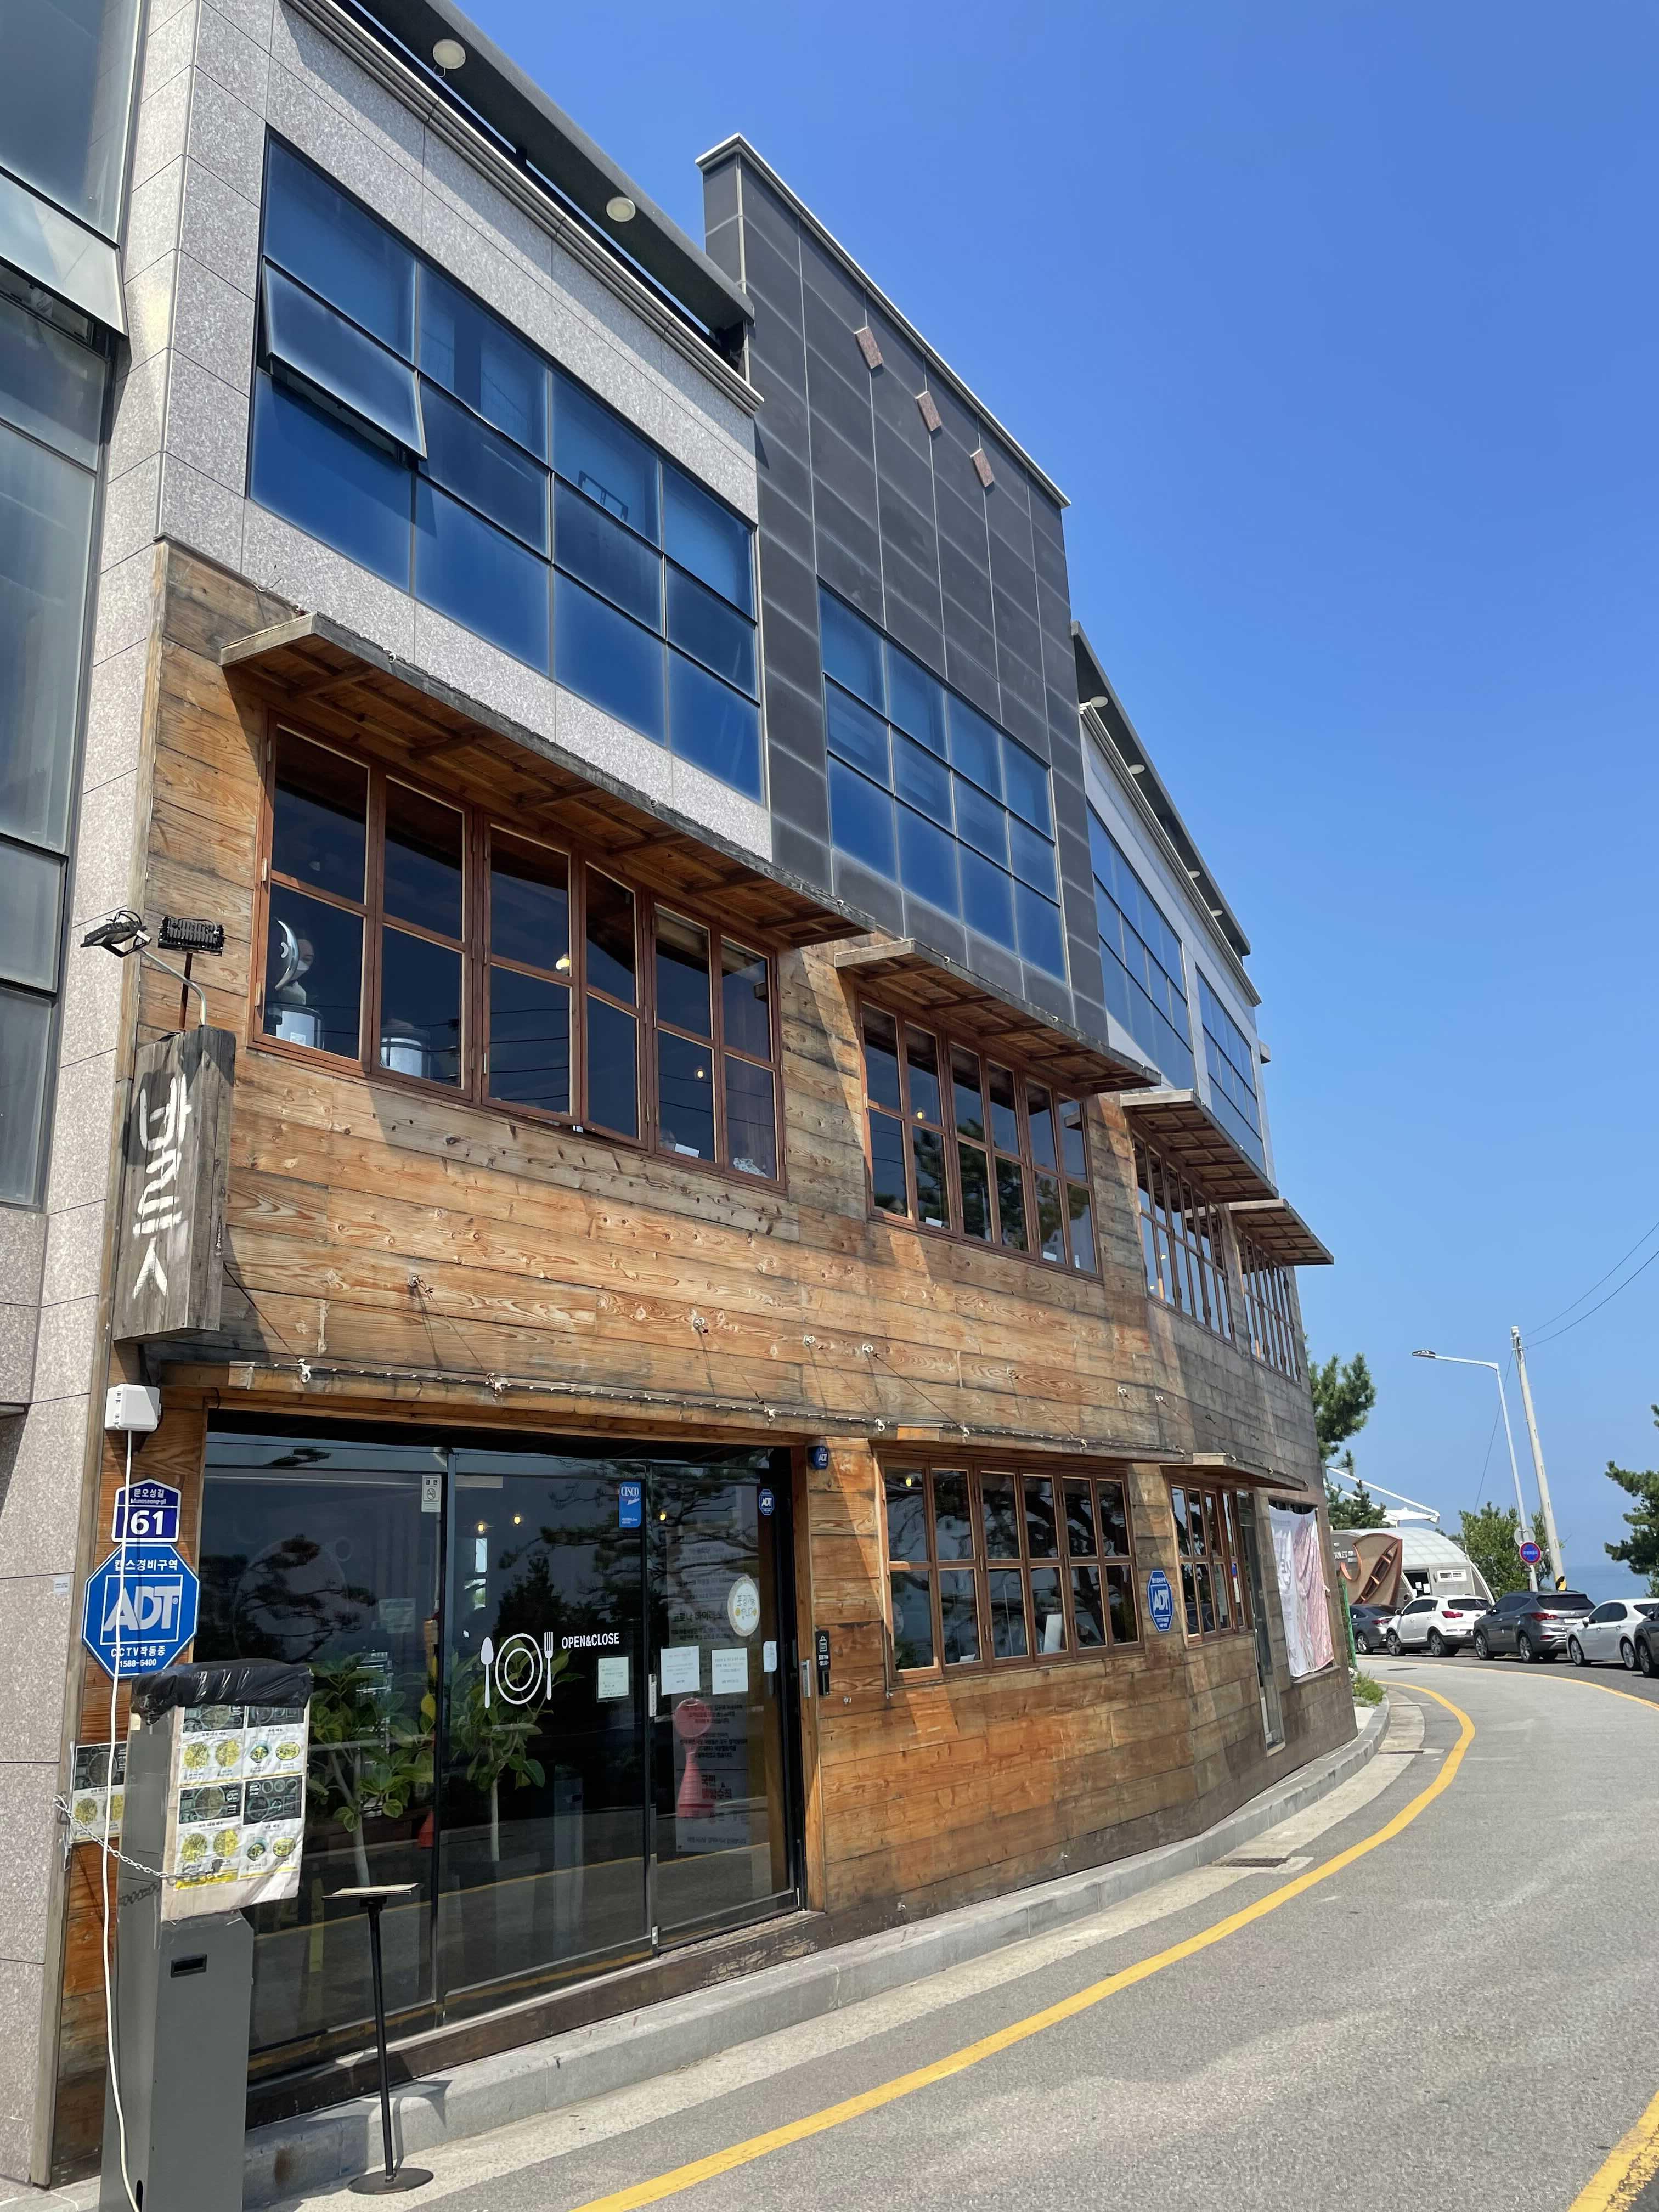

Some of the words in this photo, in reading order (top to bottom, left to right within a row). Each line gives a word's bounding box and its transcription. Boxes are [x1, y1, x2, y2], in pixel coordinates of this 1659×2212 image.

[817, 1453, 827, 1462] ADT
[134, 1488, 165, 1498] 문오성길
[620, 1486, 639, 1497] CESCO
[761, 1497, 772, 1506] ADT
[131, 1510, 164, 1535] 61
[1153, 1589, 1169, 1611] ADT
[103, 1585, 181, 1631] ADT
[561, 1632, 619, 1649] OPEN&CLOSE
